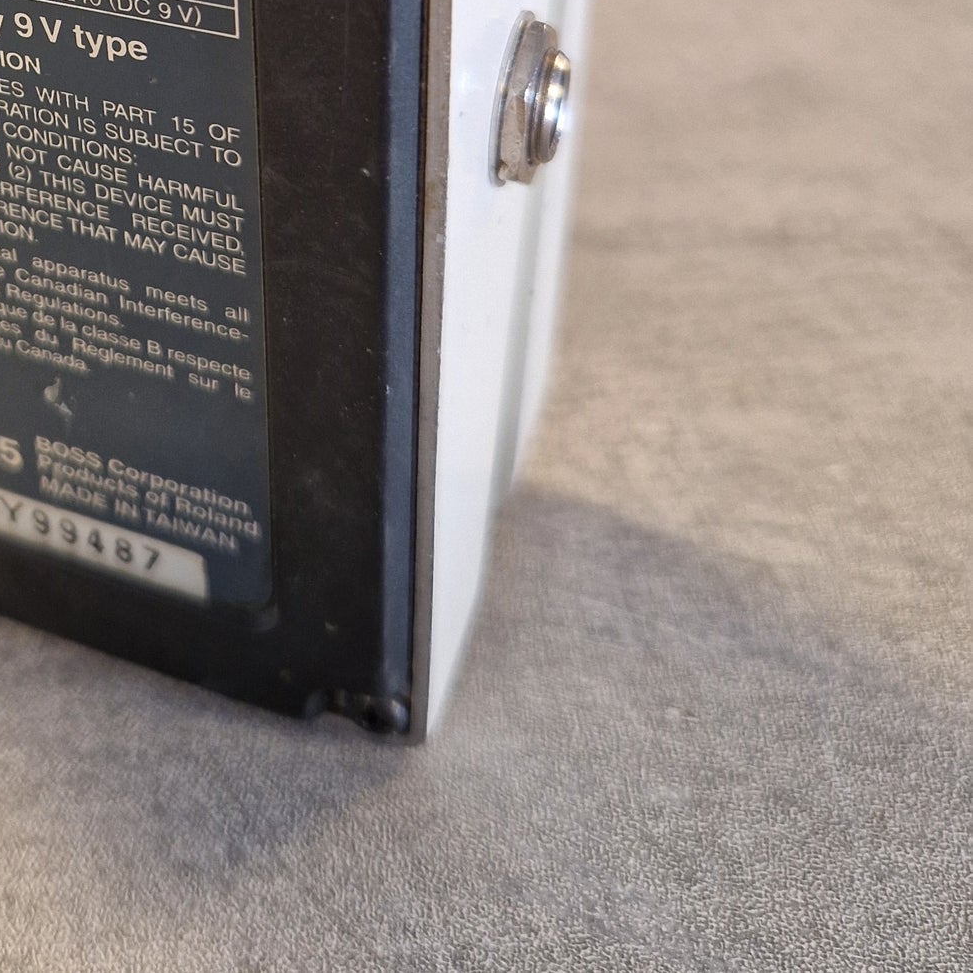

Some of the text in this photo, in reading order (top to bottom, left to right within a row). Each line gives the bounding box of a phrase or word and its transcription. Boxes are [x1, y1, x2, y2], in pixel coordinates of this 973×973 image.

[14, 12, 33, 38] 9
[39, 16, 62, 43] V
[72, 24, 148, 62] type
[158, 2, 172, 20] 9
[177, 4, 202, 27] V)
[2, 121, 137, 166] CONDITIONS:
[35, 86, 90, 112] WITH
[102, 100, 157, 126] PART
[171, 116, 196, 135] 15
[208, 123, 241, 144] OF
[77, 116, 97, 135] IS
[104, 122, 204, 159] SUBJECT
[209, 145, 242, 167] TO
[6, 142, 48, 165] NOT
[57, 154, 128, 185] CAUSE
[137, 172, 244, 212] HARMFUL
[8, 161, 32, 184] (2)
[39, 170, 86, 195] THIS
[94, 183, 173, 216] DEVICE
[182, 203, 244, 232] MUST
[66, 216, 118, 243] THAT
[123, 230, 166, 254] MAY
[173, 243, 246, 275] CAUSE
[131, 212, 245, 256] RECEIVED,
[5, 282, 124, 328] Regulations.
[14, 267, 108, 305] Canadian
[119, 294, 249, 340] Interference-
[32, 256, 130, 292] apparatus
[145, 285, 208, 312] meets
[224, 306, 248, 323] all
[32, 309, 56, 327] de
[60, 315, 78, 334] la
[81, 324, 142, 351] classe
[147, 339, 162, 356] B
[167, 348, 251, 381] respecte
[34, 435, 249, 516] BOSS Corporation
[37, 452, 260, 538] Products of Roland
